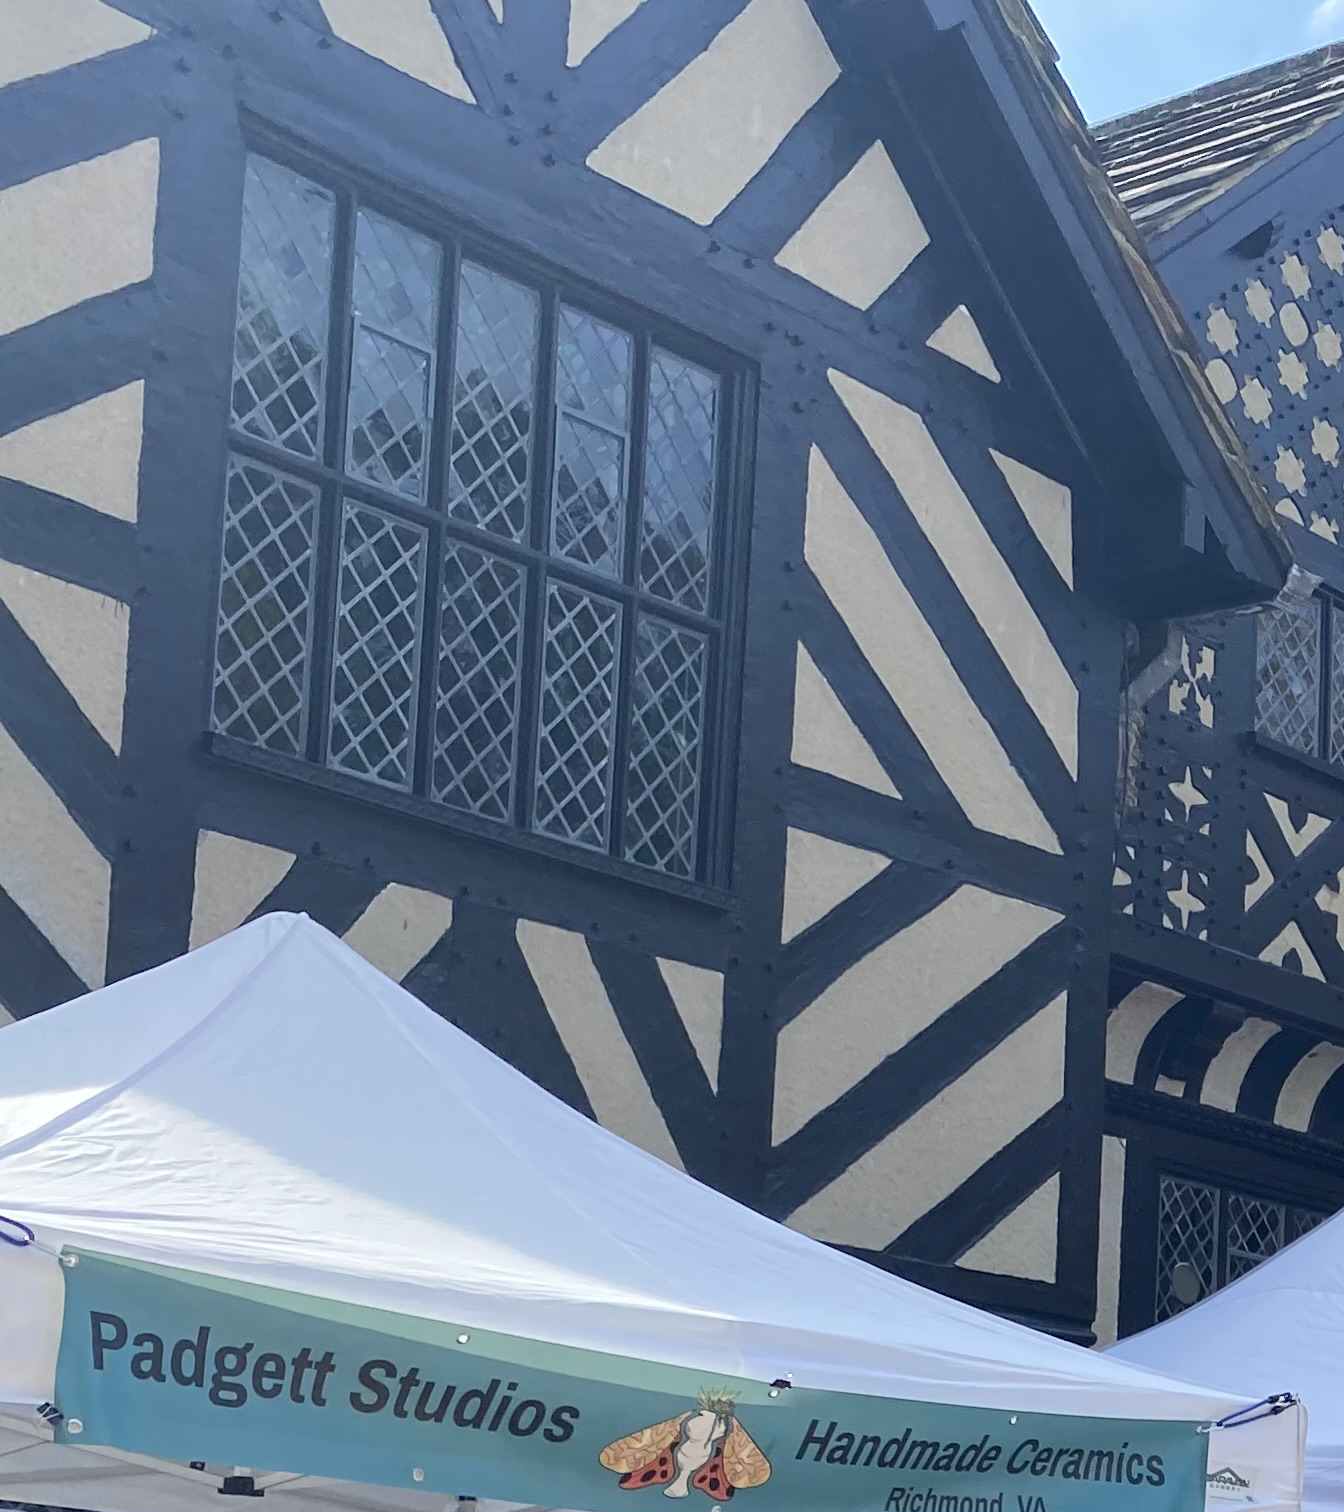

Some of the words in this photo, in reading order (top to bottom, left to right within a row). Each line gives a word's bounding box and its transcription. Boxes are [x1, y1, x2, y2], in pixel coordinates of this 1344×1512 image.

[88, 1310, 337, 1408] Padgett
[349, 1358, 581, 1443] Studios
[795, 1418, 1001, 1473] Handmade
[1006, 1437, 1166, 1487] Ceramics
